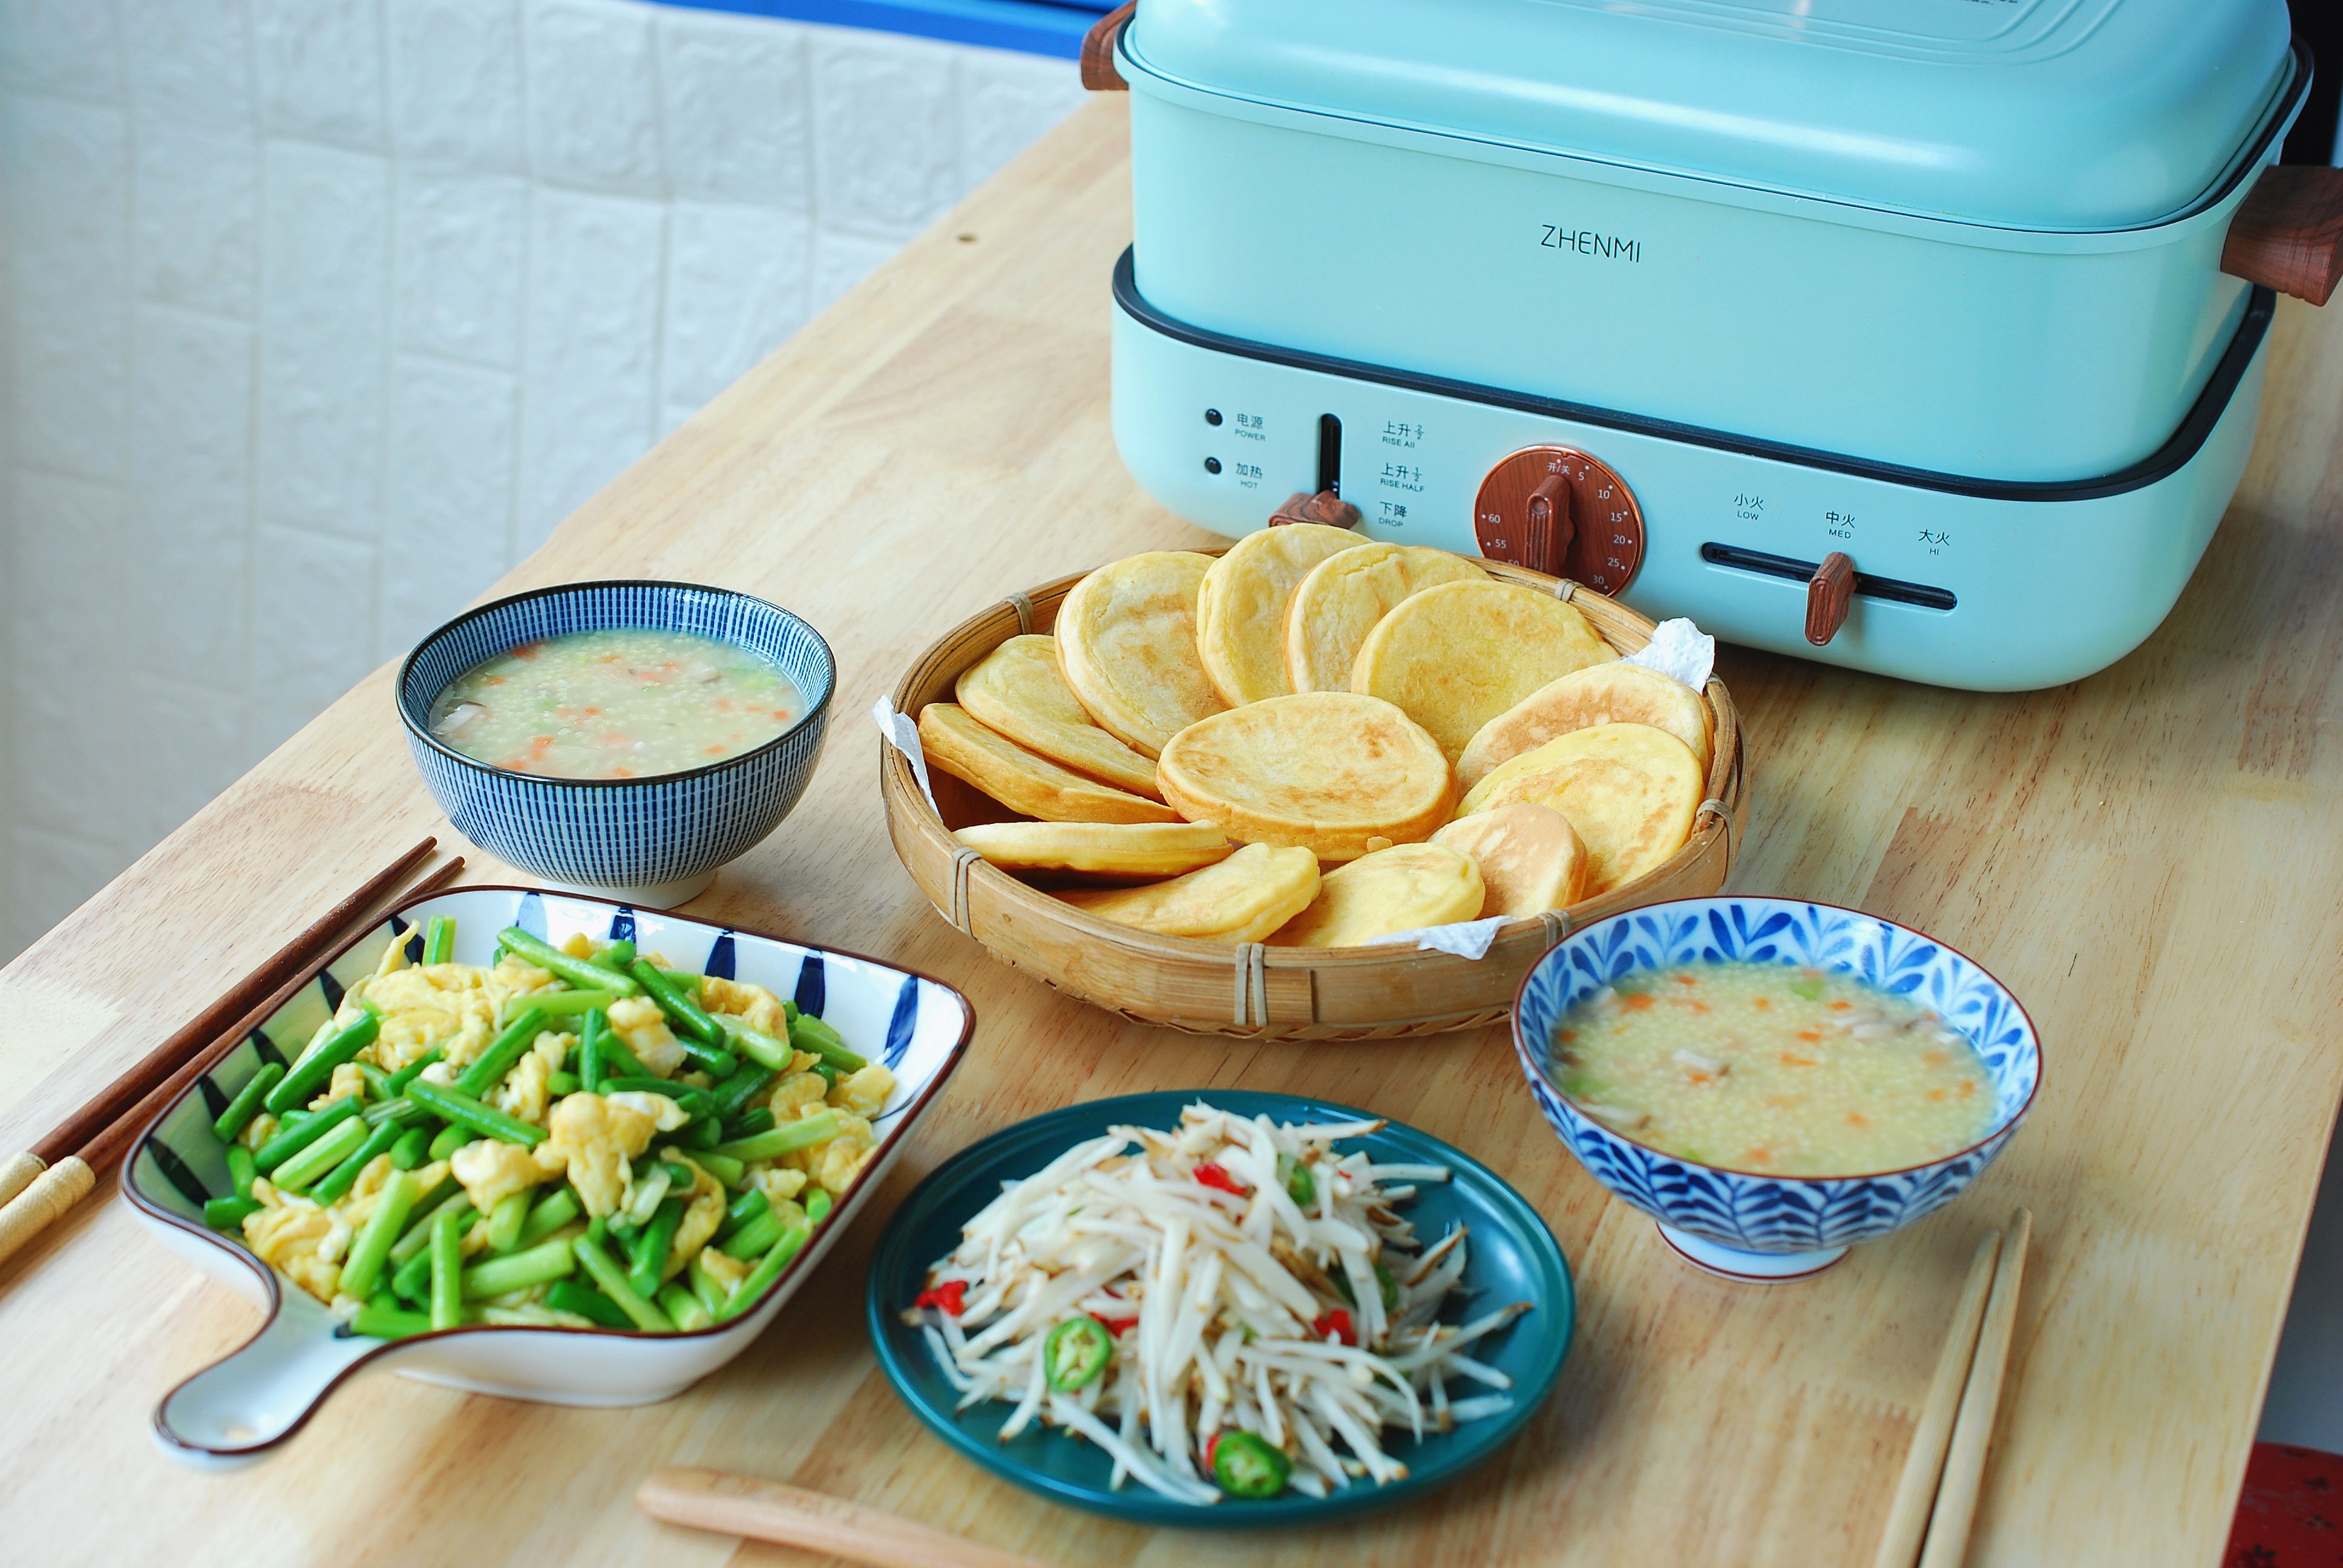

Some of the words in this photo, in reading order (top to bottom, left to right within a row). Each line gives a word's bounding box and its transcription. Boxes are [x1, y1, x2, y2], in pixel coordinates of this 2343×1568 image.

[1541, 224, 1640, 263] ZHENMI
[1237, 413, 1264, 430] 电源
[1383, 421, 1411, 437] 上升
[1235, 429, 1266, 441] POWER
[1382, 437, 1402, 447] RISE
[1236, 462, 1263, 480] 加热
[1381, 462, 1409, 479] 上升
[1547, 462, 1571, 475] 开/关
[1578, 471, 1585, 481] 5
[1240, 480, 1259, 489] HOT
[1380, 478, 1400, 488] RISE
[1401, 481, 1425, 492] HALF
[1598, 489, 1610, 499] 10
[1733, 493, 1764, 511] 小火
[1380, 501, 1407, 518] 下降
[1489, 514, 1501, 524] 60
[1610, 512, 1622, 523] 15
[1737, 510, 1759, 521] LOW
[1825, 511, 1856, 529] 中火
[1378, 517, 1404, 528] DROP
[1613, 535, 1625, 544] 20
[1828, 529, 1852, 540] MED
[1918, 528, 1950, 546] 大火
[1495, 538, 1507, 549] 55
[1928, 547, 1940, 556] HI
[1607, 557, 1620, 567] 25
[1593, 575, 1605, 584] 30
